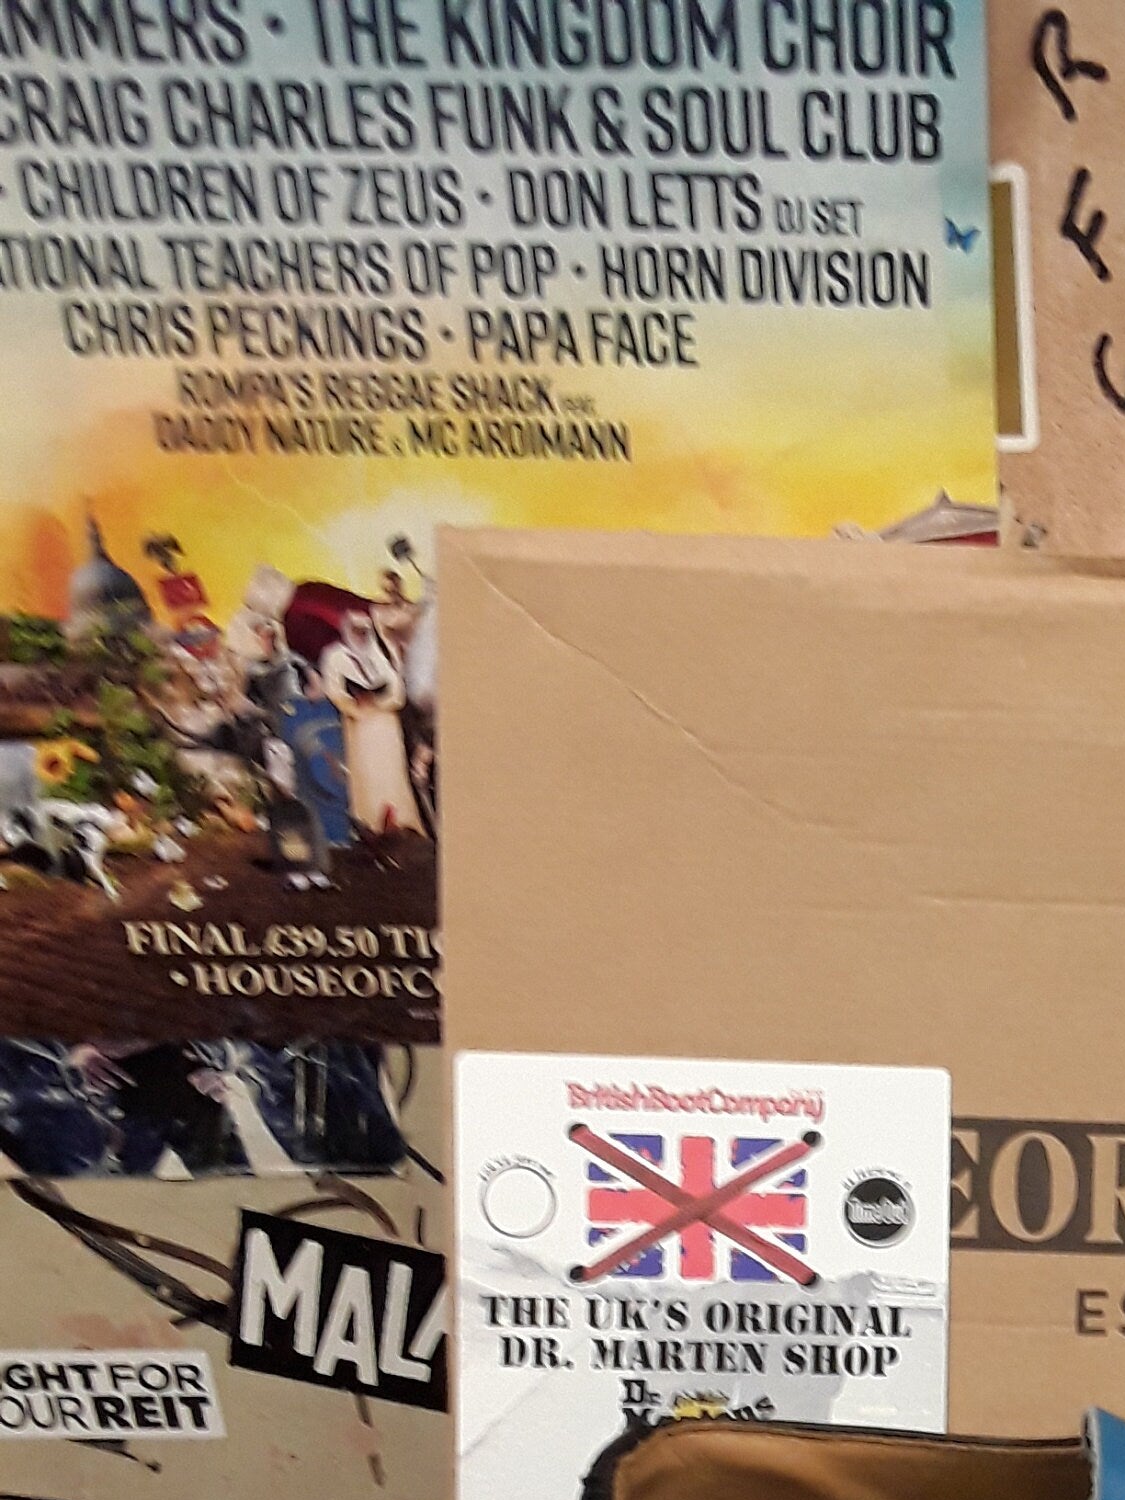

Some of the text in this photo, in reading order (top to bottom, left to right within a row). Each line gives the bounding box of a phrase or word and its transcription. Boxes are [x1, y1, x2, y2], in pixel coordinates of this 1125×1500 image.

[0, 0, 956, 79] MMERS THE KINGDOM CHOIR
[166, 78, 416, 153] CHARLES
[429, 83, 578, 156] FUNK
[593, 86, 634, 158] &
[643, 88, 788, 160] SOUL
[803, 92, 941, 163] CLUB
[20, 160, 262, 226] CHILDREN
[273, 164, 331, 226] OF
[342, 166, 466, 228] ZEUS
[509, 167, 613, 231] DON
[625, 170, 762, 234] LETTS
[812, 200, 864, 237] SET
[0, 234, 932, 309] TIONAL TEACHERS OF POP HORN DIVISION
[63, 301, 700, 367] CHRIS PECKINGS PAPA FACE
[321, 370, 445, 414] REGGAE
[450, 372, 559, 416] SHACK
[263, 412, 387, 457] NATURE
[406, 416, 459, 459] MC
[122, 920, 263, 957] FINAL
[482, 1295, 912, 1340] THE UK'S ORIGINAL
[0, 1363, 208, 1392] GHT FOR
[500, 1334, 900, 1378] DR. MARTEN SHOP
[91, 1396, 211, 1430] REIT
